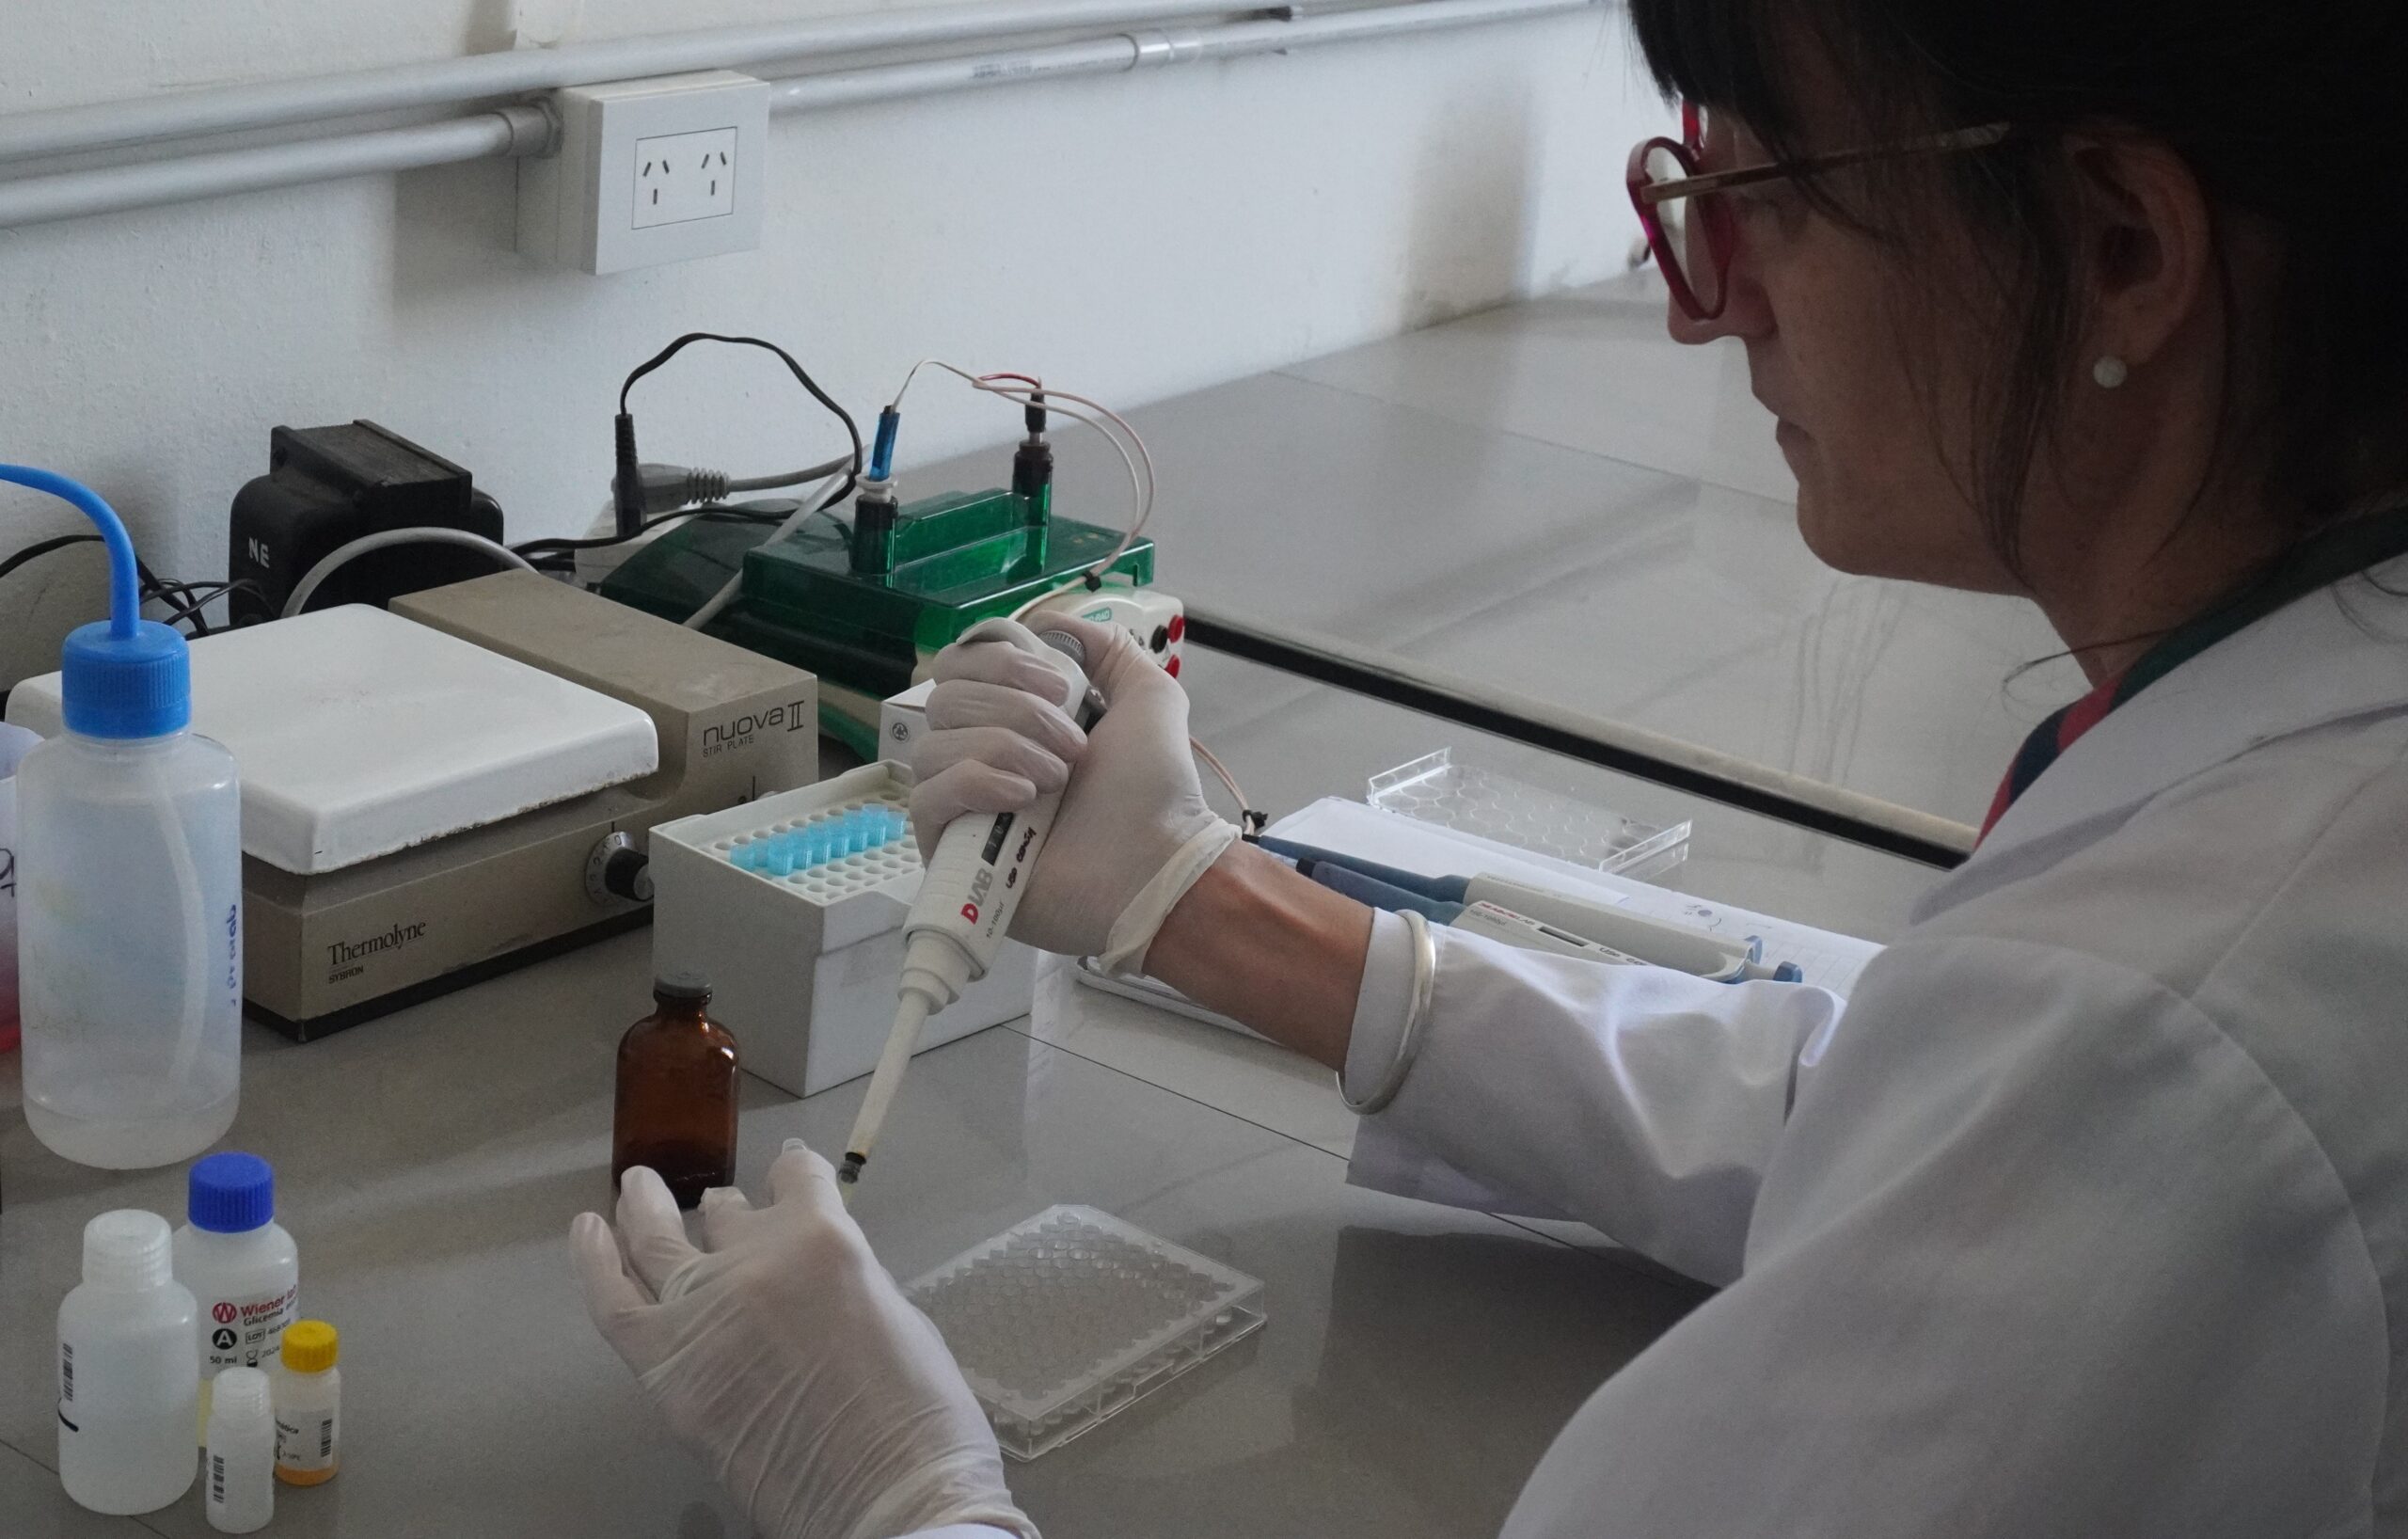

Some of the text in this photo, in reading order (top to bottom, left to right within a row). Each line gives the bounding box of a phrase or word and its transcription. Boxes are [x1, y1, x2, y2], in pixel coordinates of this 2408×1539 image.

[248, 536, 270, 568] NE
[703, 706, 784, 746] nuova
[703, 735, 754, 757] STIR PLATE
[960, 867, 993, 925] DLAB
[327, 921, 426, 966] Thermolyne
[328, 965, 364, 984] SYBRON
[240, 1295, 285, 1317] Wiener
[244, 1308, 284, 1326] Glicemia
[215, 1329, 233, 1347] A
[209, 1356, 222, 1365] 50
